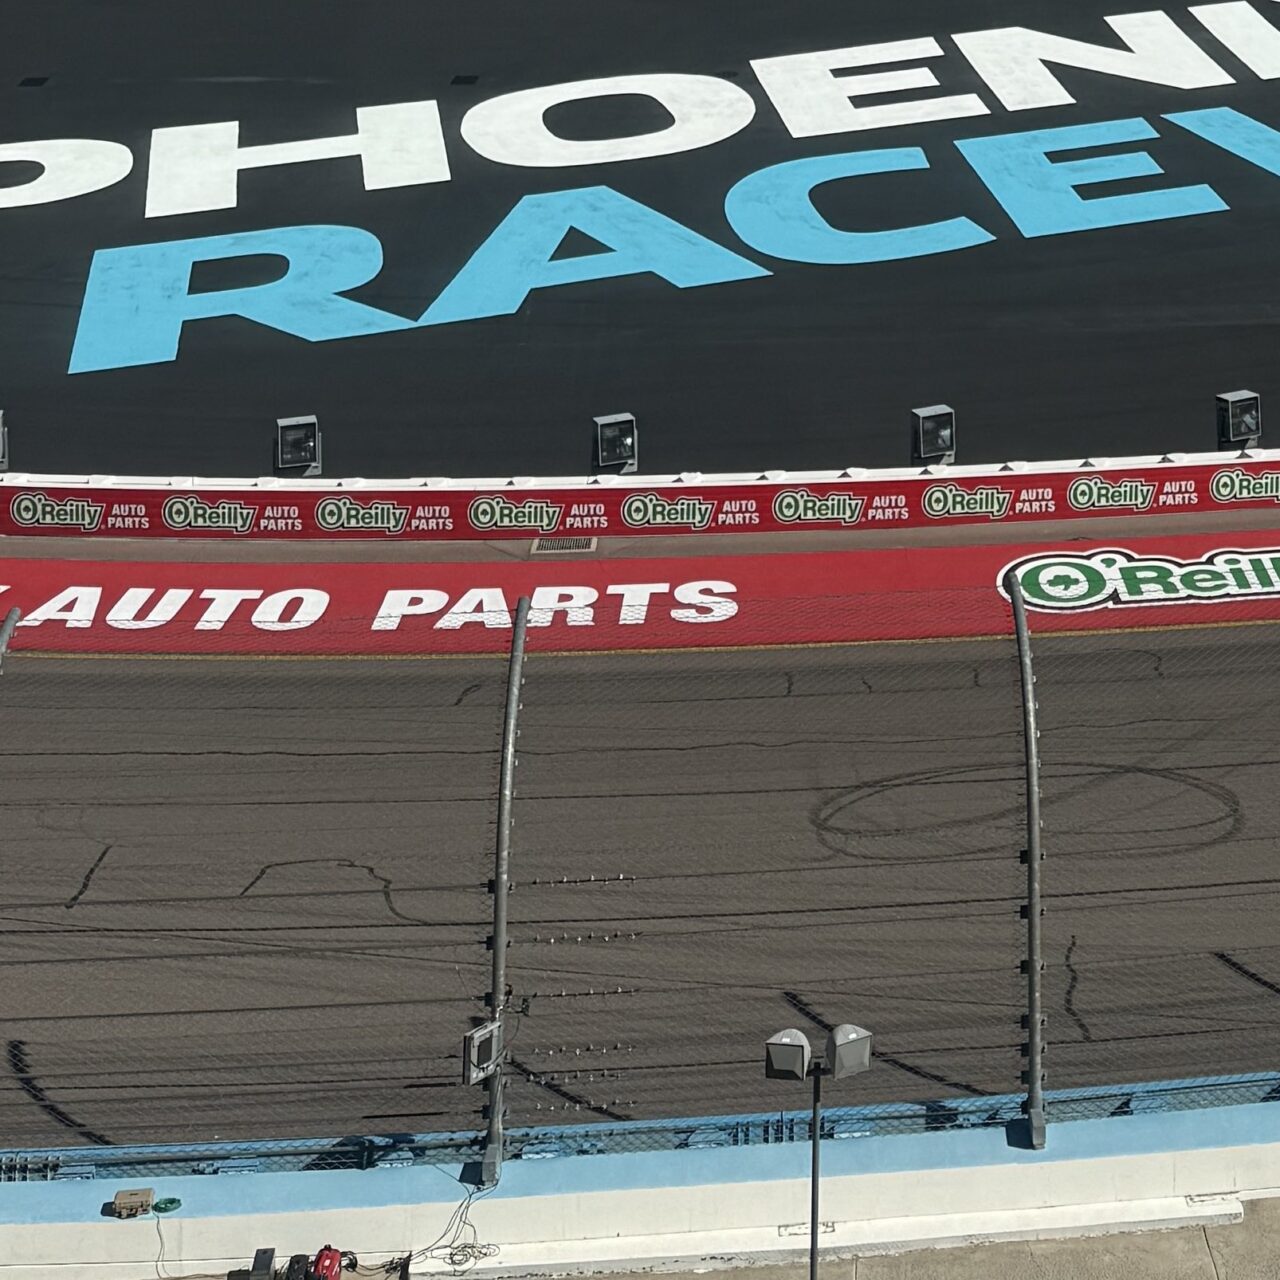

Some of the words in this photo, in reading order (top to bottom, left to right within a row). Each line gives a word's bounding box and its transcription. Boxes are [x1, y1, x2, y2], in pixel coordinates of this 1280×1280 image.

[1019, 488, 1053, 501] AUTO
[1071, 478, 1153, 510] O'Reilly
[1163, 481, 1196, 494] AUTO
[775, 489, 862, 523] O'Reilly
[872, 495, 906, 508] AUTO
[926, 485, 1010, 516] O'Reilly
[1159, 492, 1198, 506] PARTS
[13, 493, 101, 530] O'Reilly
[111, 504, 146, 516] AUTO
[165, 495, 254, 532] O'Reilly
[264, 506, 299, 518] AUTO
[415, 505, 450, 518] AUTO
[471, 496, 560, 530] O'Reilly
[570, 504, 605, 516] AUTO
[623, 493, 712, 528] O'Reilly
[722, 500, 757, 513] AUTO
[1015, 500, 1056, 513] PARTS
[317, 497, 407, 532] O'Reilly
[717, 511, 760, 525] PARTS
[868, 507, 910, 521] PARTS
[107, 516, 150, 530] PARTS
[260, 517, 303, 531] PARTS
[411, 517, 455, 531] PARTS
[566, 515, 609, 529] PARTS
[16, 585, 331, 631] AUTO
[370, 580, 739, 630] PARTS
